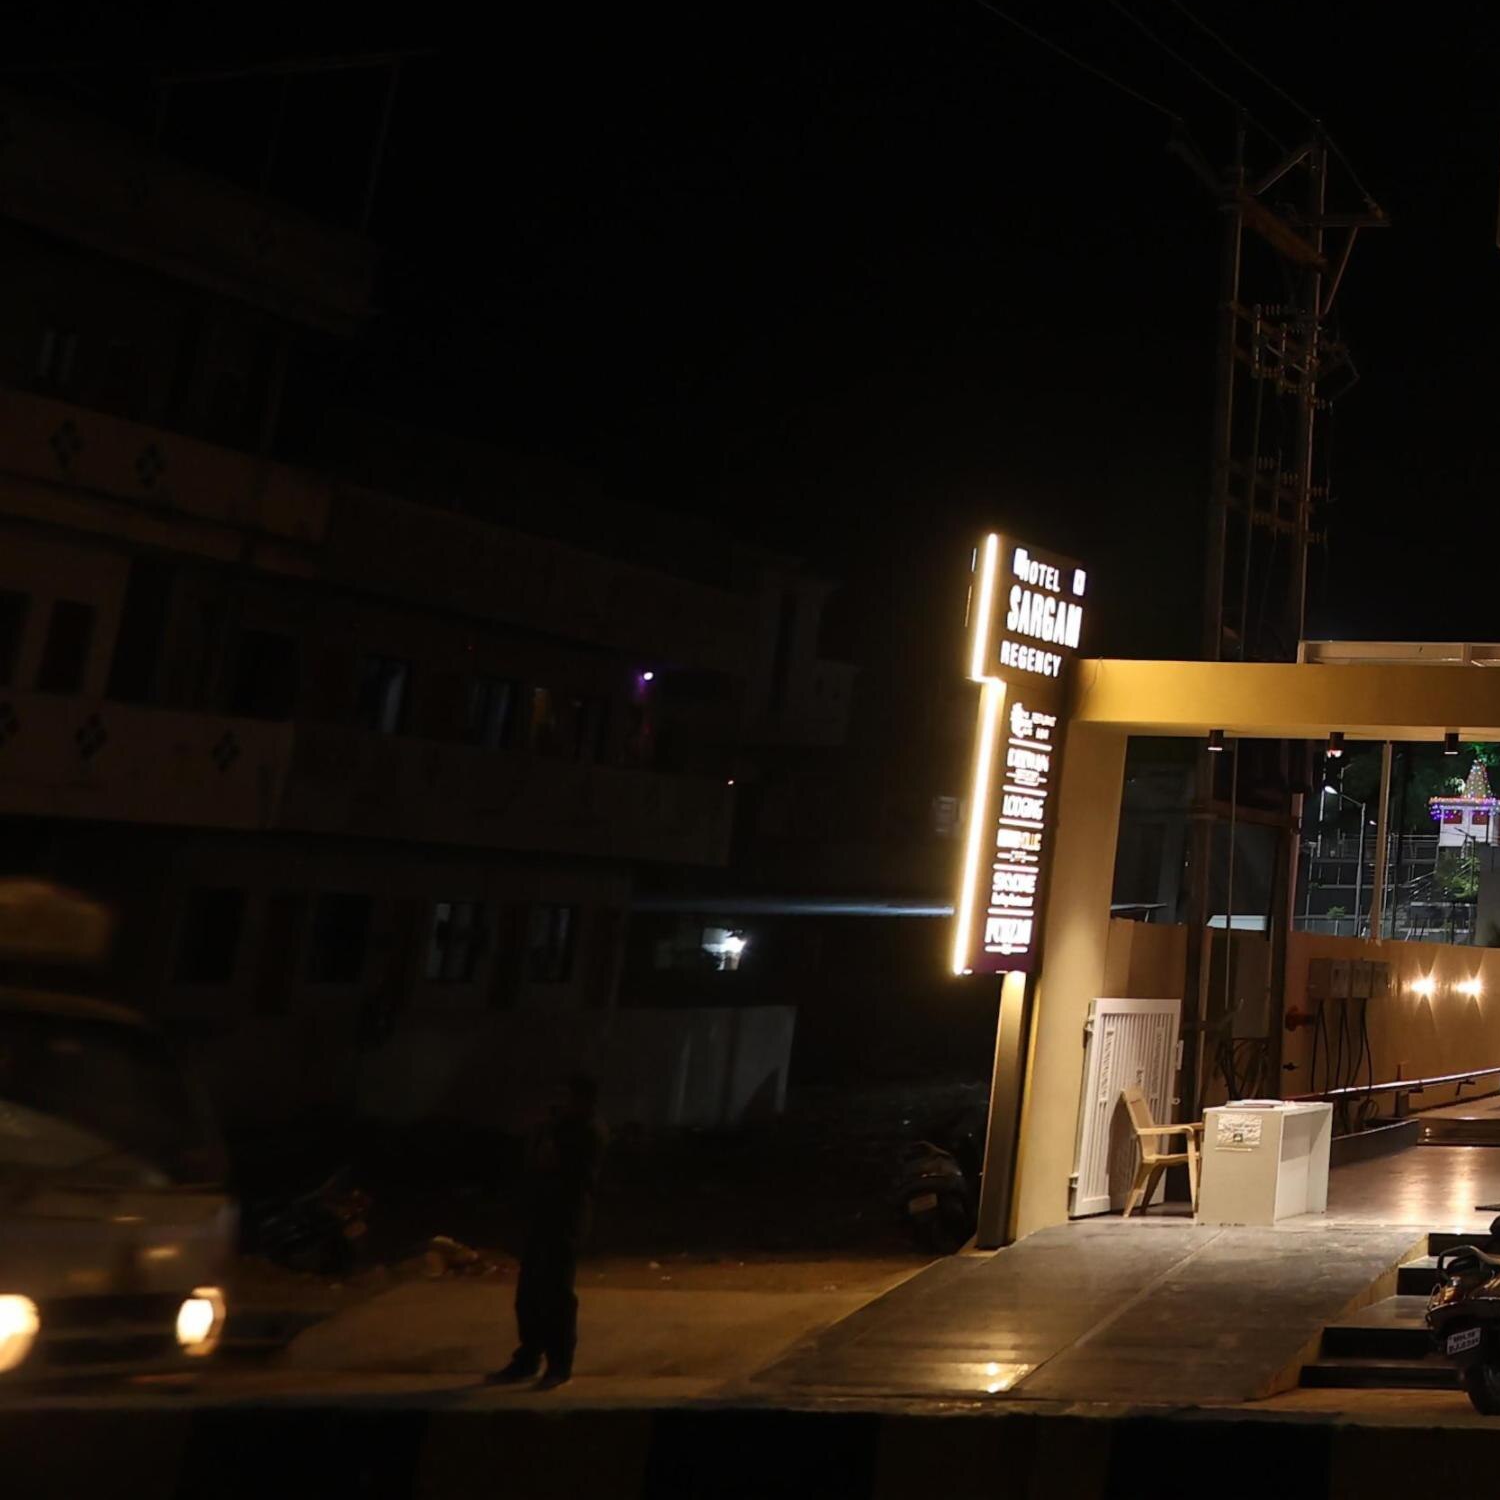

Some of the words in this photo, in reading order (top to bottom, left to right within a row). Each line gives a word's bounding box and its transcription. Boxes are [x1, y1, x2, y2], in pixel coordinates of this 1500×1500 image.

[1019, 559, 1060, 593] HOTEL
[1007, 584, 1083, 649] SARGAM
[1000, 640, 1061, 678] REGENCY
